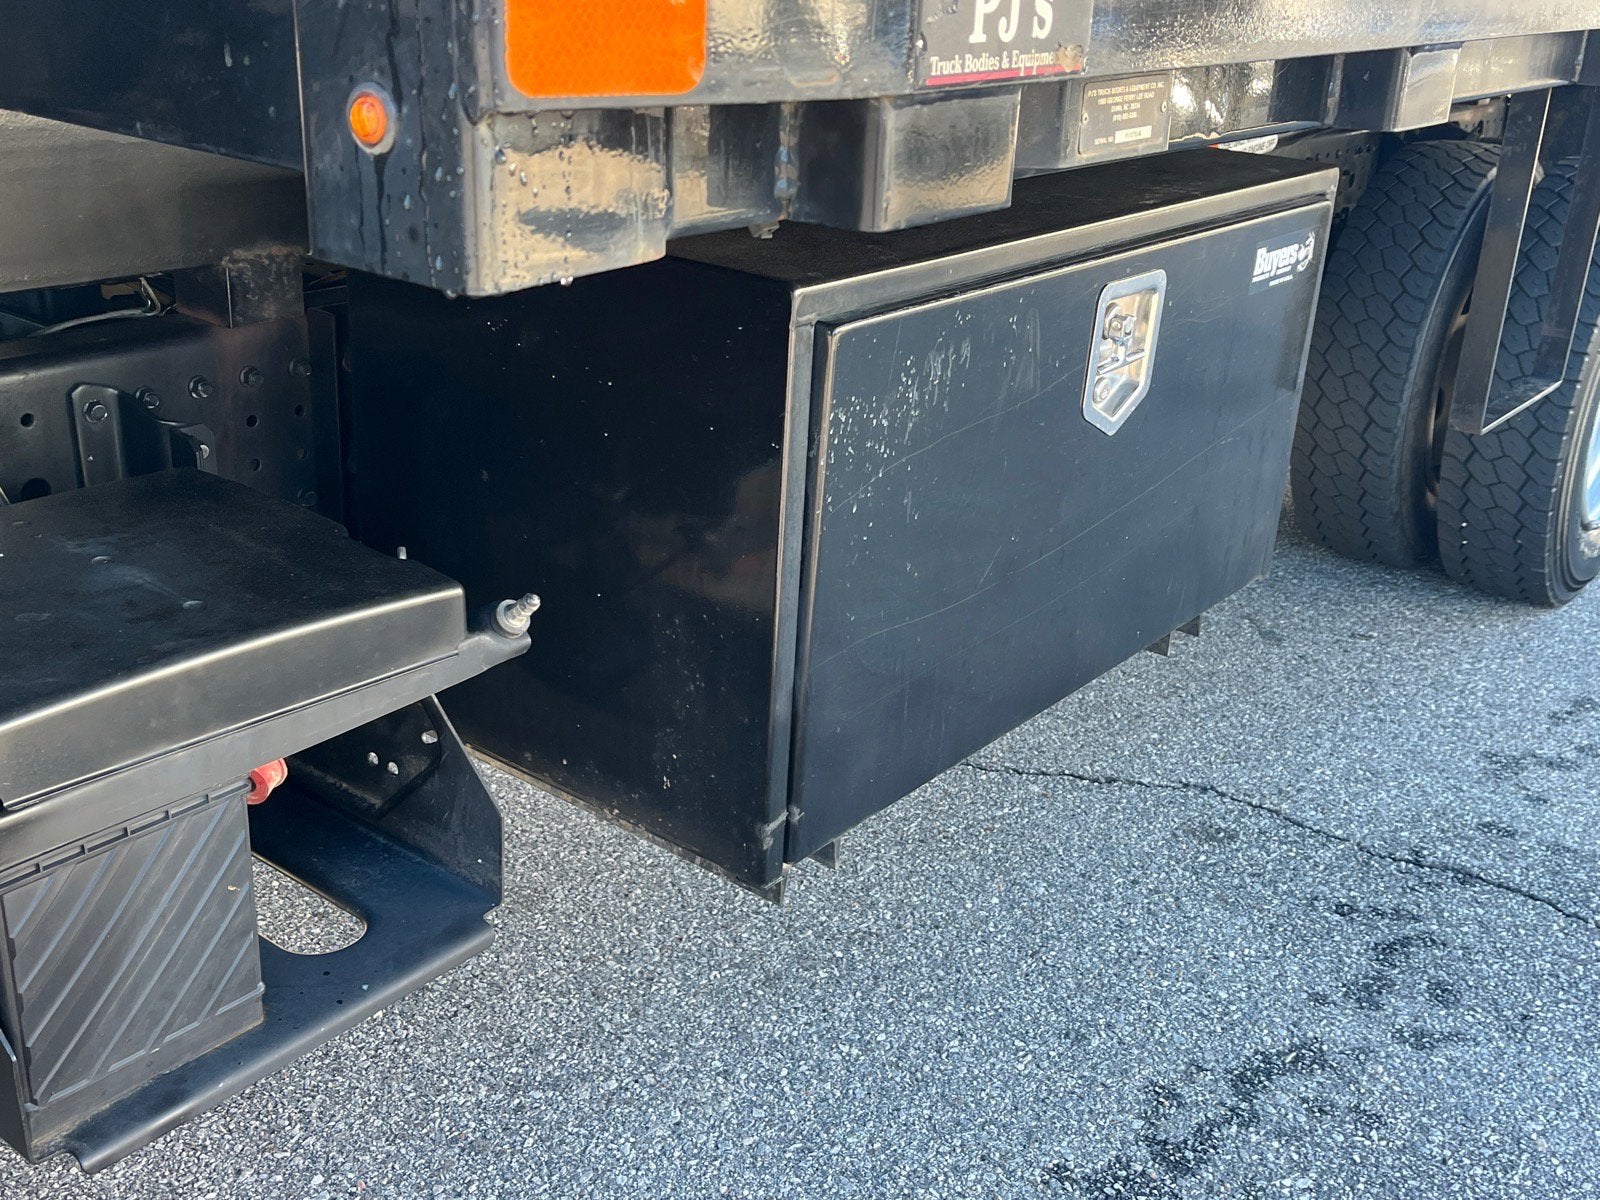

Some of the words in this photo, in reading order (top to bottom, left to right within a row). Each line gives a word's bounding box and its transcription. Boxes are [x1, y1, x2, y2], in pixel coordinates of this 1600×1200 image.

[930, 54, 963, 76] Truck
[964, 52, 1000, 72] Bodies
[1001, 51, 1010, 69] &
[1011, 49, 1066, 76] Equipme
[1097, 88, 1111, 96] TRUCK
[1129, 83, 1150, 92] EQUIPMENT
[1253, 243, 1299, 277] Buyers
